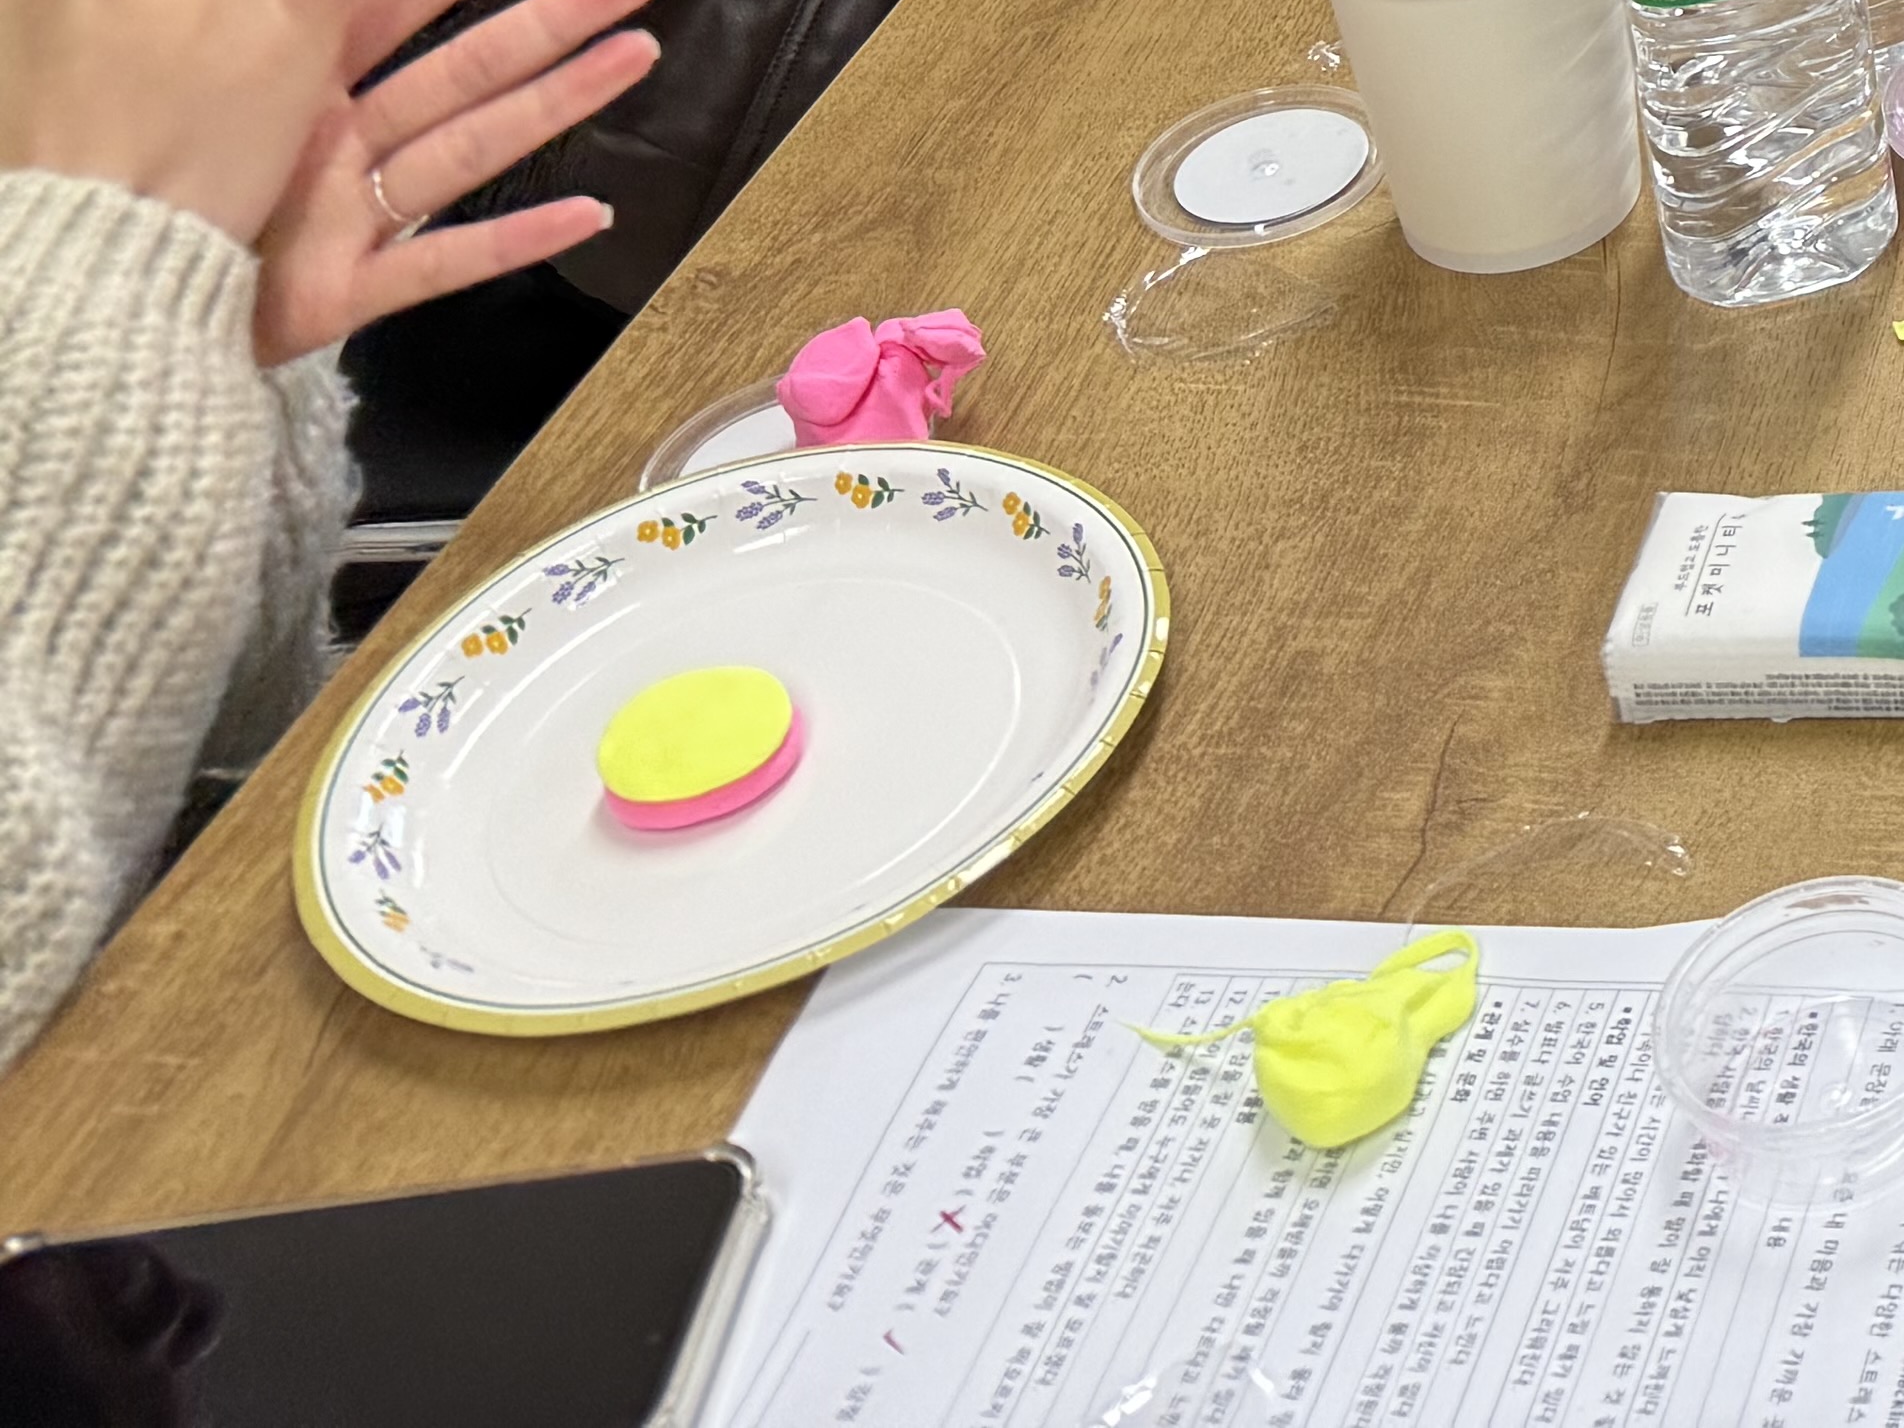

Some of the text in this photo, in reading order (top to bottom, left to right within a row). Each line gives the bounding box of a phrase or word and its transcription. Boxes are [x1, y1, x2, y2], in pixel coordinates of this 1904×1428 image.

[1552, 1000, 1571, 1013] 6.
[1585, 1001, 1605, 1014] 5.
[1449, 1012, 1502, 1103] 관계 및 문화
[1531, 1020, 1564, 1064] 발표나
[1564, 1021, 1597, 1065] 한국어
[1582, 1017, 1631, 1106] 학업 및 언어
[1510, 1073, 1544, 1118] 글쓰기
[1549, 1074, 1575, 1103] 수업
[1529, 1112, 1561, 1158] 내용을
[1596, 1089, 1637, 1140] 친구가
[1489, 1128, 1523, 1173] 과제가
[1582, 1142, 1618, 1178] 있는
[1629, 1116, 1660, 1162] 시간이
[1472, 1181, 1502, 1212] 있을
[1501, 1166, 1541, 1230] 따라가기
[1563, 1185, 1601, 1249] 베트남이
[1609, 1171, 1643, 1218] 많아서
[1696, 1189, 1728, 1237] 나에게
[1463, 1221, 1485, 1237] 때
[1436, 1247, 1475, 1312] 긴장되고
[1474, 1239, 1512, 1304] 어렵다고
[1549, 1258, 1575, 1290] 자주
[1585, 1228, 1622, 1291] 외롭다고
[1683, 1245, 1711, 1278] 아직
[1663, 1287, 1696, 1337] 낯설게
[1869, 1283, 1903, 1337] 다양한
[1847, 1349, 1881, 1423] 스트레스
